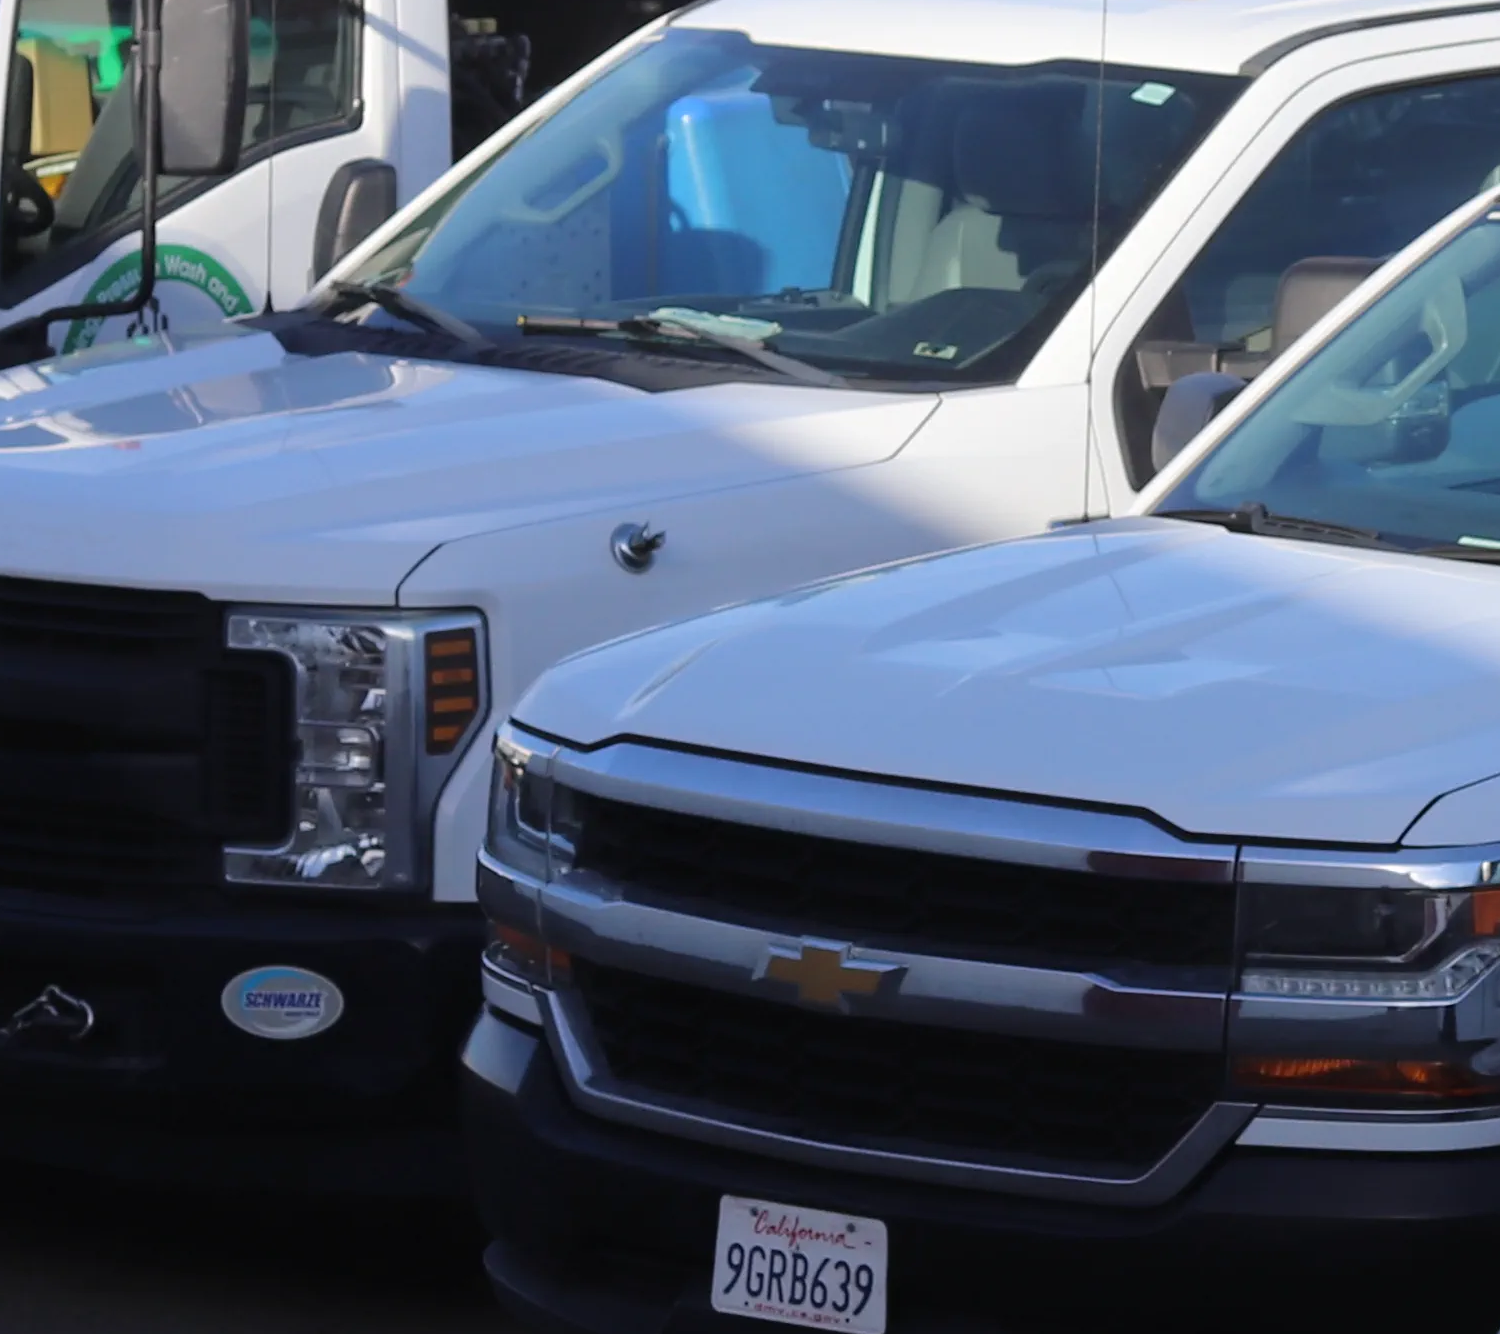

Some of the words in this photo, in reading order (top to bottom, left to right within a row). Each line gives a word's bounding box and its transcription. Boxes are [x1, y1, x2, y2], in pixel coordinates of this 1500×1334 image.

[164, 254, 207, 283] Wash
[207, 277, 241, 313] and
[244, 992, 323, 1009] SCHWARZE
[754, 1210, 856, 1249] California
[722, 1242, 874, 1316] 9GRB639
